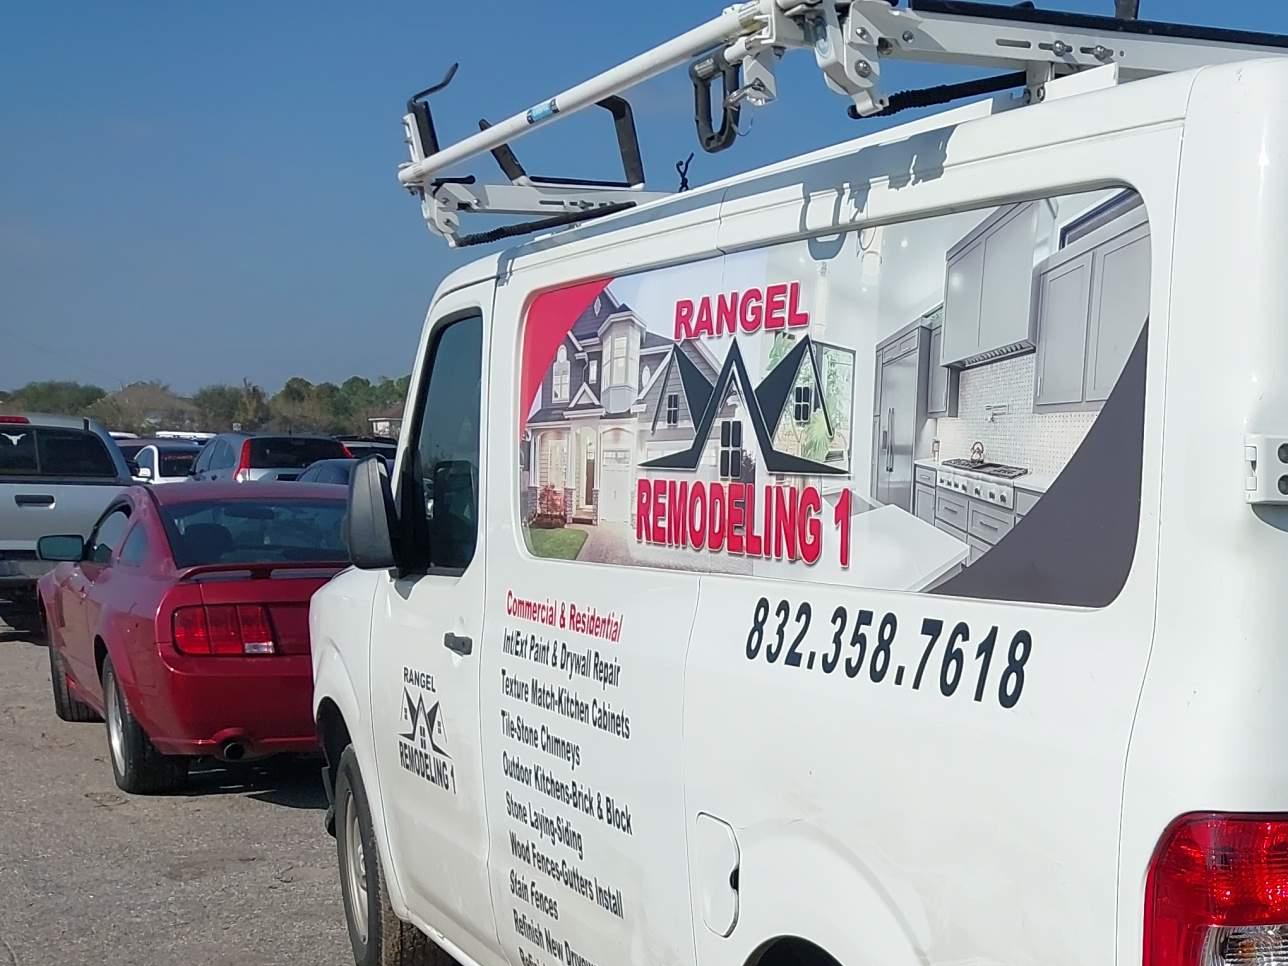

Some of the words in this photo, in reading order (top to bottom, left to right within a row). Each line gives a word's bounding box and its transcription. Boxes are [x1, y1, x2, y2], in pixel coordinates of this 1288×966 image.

[673, 280, 810, 342] RANGEL
[636, 478, 823, 566] REMODELING
[834, 486, 853, 569] 1
[507, 590, 557, 627] Commercial
[560, 601, 566, 629] &
[569, 603, 624, 642] Residential
[403, 666, 436, 693] RANGEL
[529, 634, 550, 666] Paint
[552, 640, 558, 667] &
[560, 642, 592, 680] Drywall
[593, 651, 621, 691] Repair
[746, 597, 1033, 709] 832.358.7618
[501, 668, 529, 702] Texture
[531, 678, 590, 725] Match-Kitchen
[592, 699, 630, 739] Cabinets
[399, 740, 449, 791] REMODELING
[450, 764, 456, 795] 1
[501, 709, 539, 748] Tile-Stone
[541, 724, 580, 771] Chimneys
[503, 750, 532, 787] Outdoor
[534, 763, 595, 817] Kitchens-Brick
[597, 792, 604, 820] &
[606, 796, 632, 835] Block
[506, 791, 528, 824] Stone
[528, 802, 583, 860] Laying-Siding
[509, 829, 531, 864] Wood
[531, 842, 594, 901] Fences-Gutters
[594, 877, 624, 919] Install
[510, 869, 529, 903] Stain
[531, 881, 558, 920] Fences
[513, 908, 545, 950] Refinish
[544, 928, 564, 961] New
